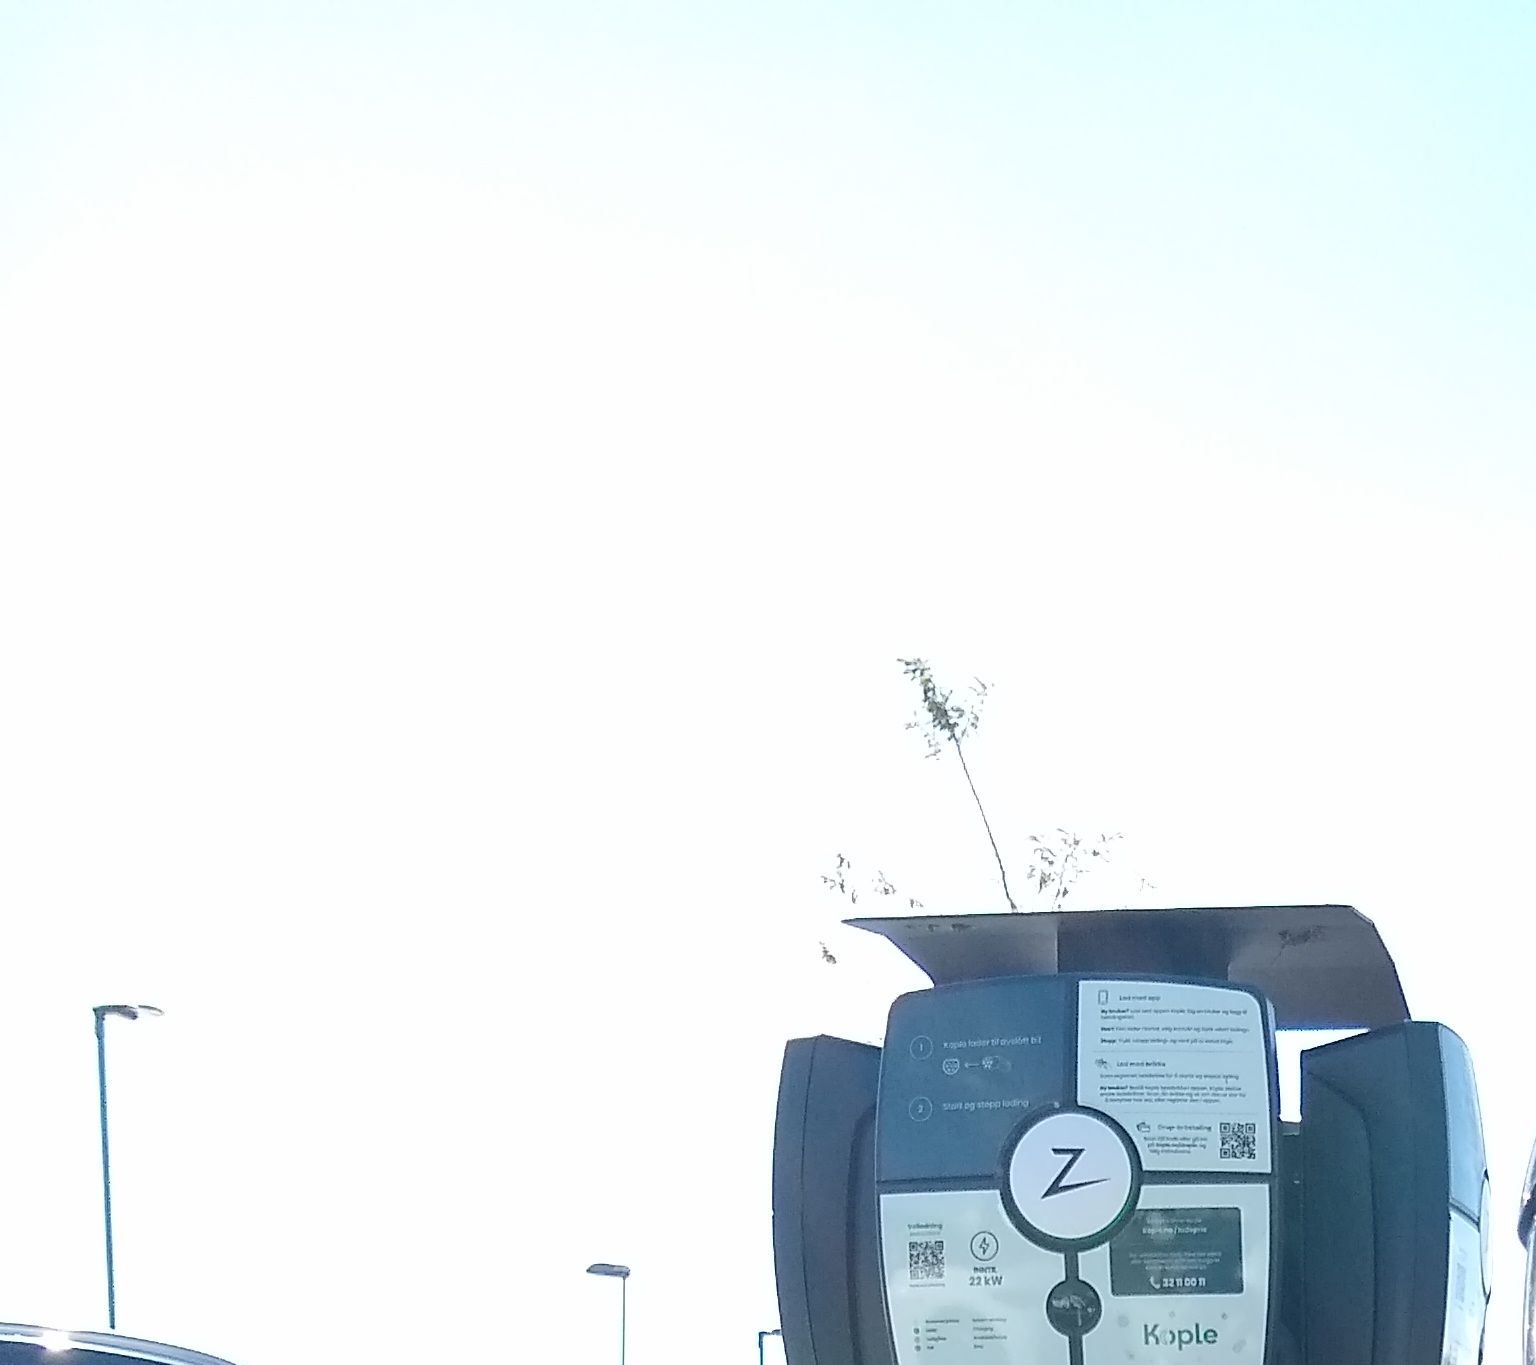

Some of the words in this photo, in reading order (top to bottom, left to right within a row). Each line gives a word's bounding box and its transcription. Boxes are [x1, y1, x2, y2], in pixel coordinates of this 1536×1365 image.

[969, 1276, 983, 1287] 22
[984, 1276, 1003, 1286] kW
[1144, 1323, 1218, 1351] Kople
